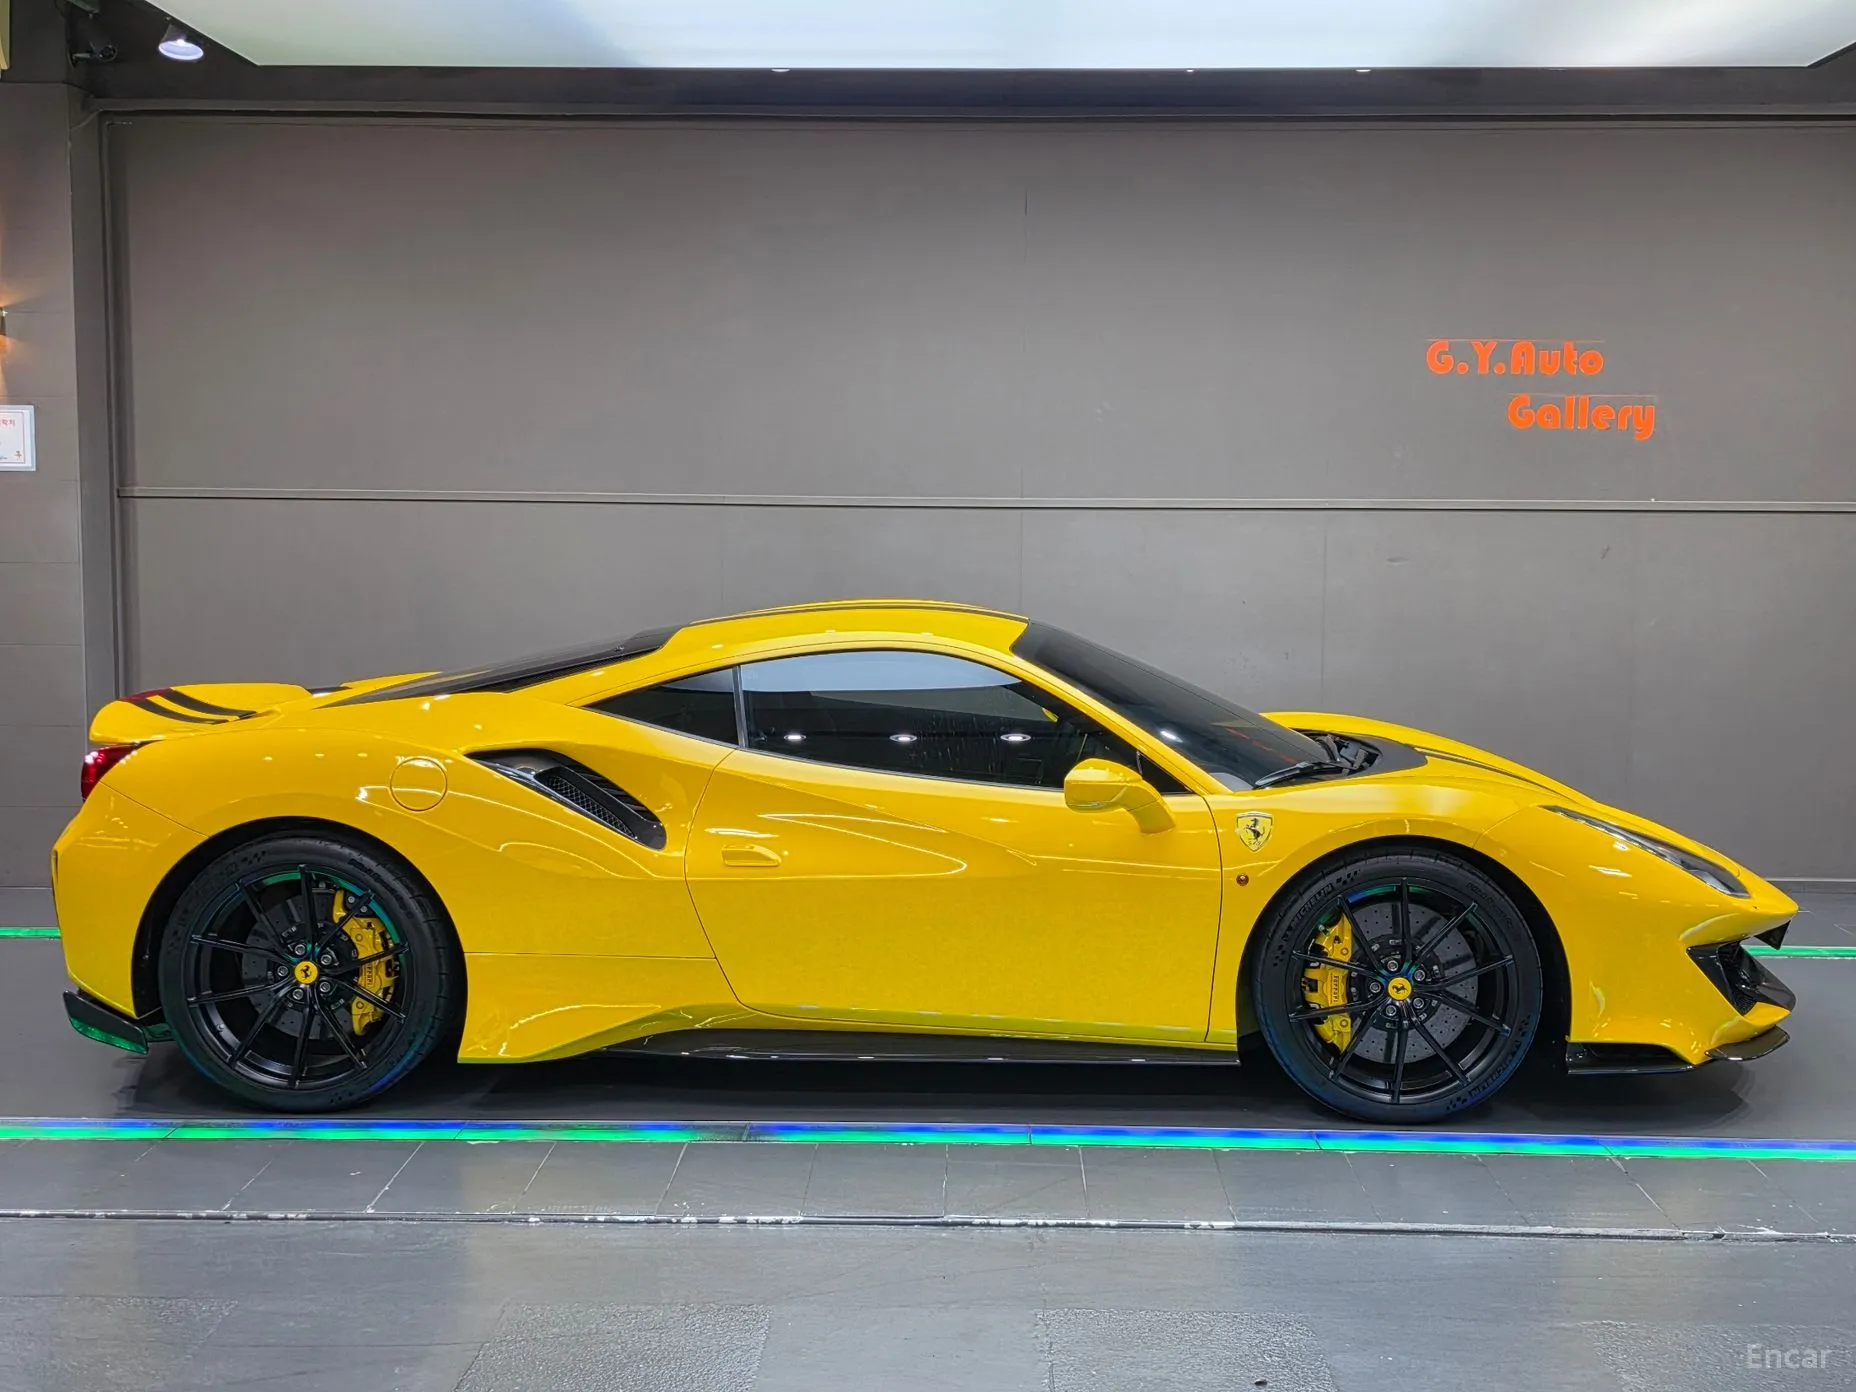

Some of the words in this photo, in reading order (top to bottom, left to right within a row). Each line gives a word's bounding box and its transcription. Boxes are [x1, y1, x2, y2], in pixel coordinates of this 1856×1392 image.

[1426, 340, 1604, 375] G.Y.Auto
[1507, 393, 1656, 441] Gallery
[1290, 883, 1335, 927] MICHELIN
